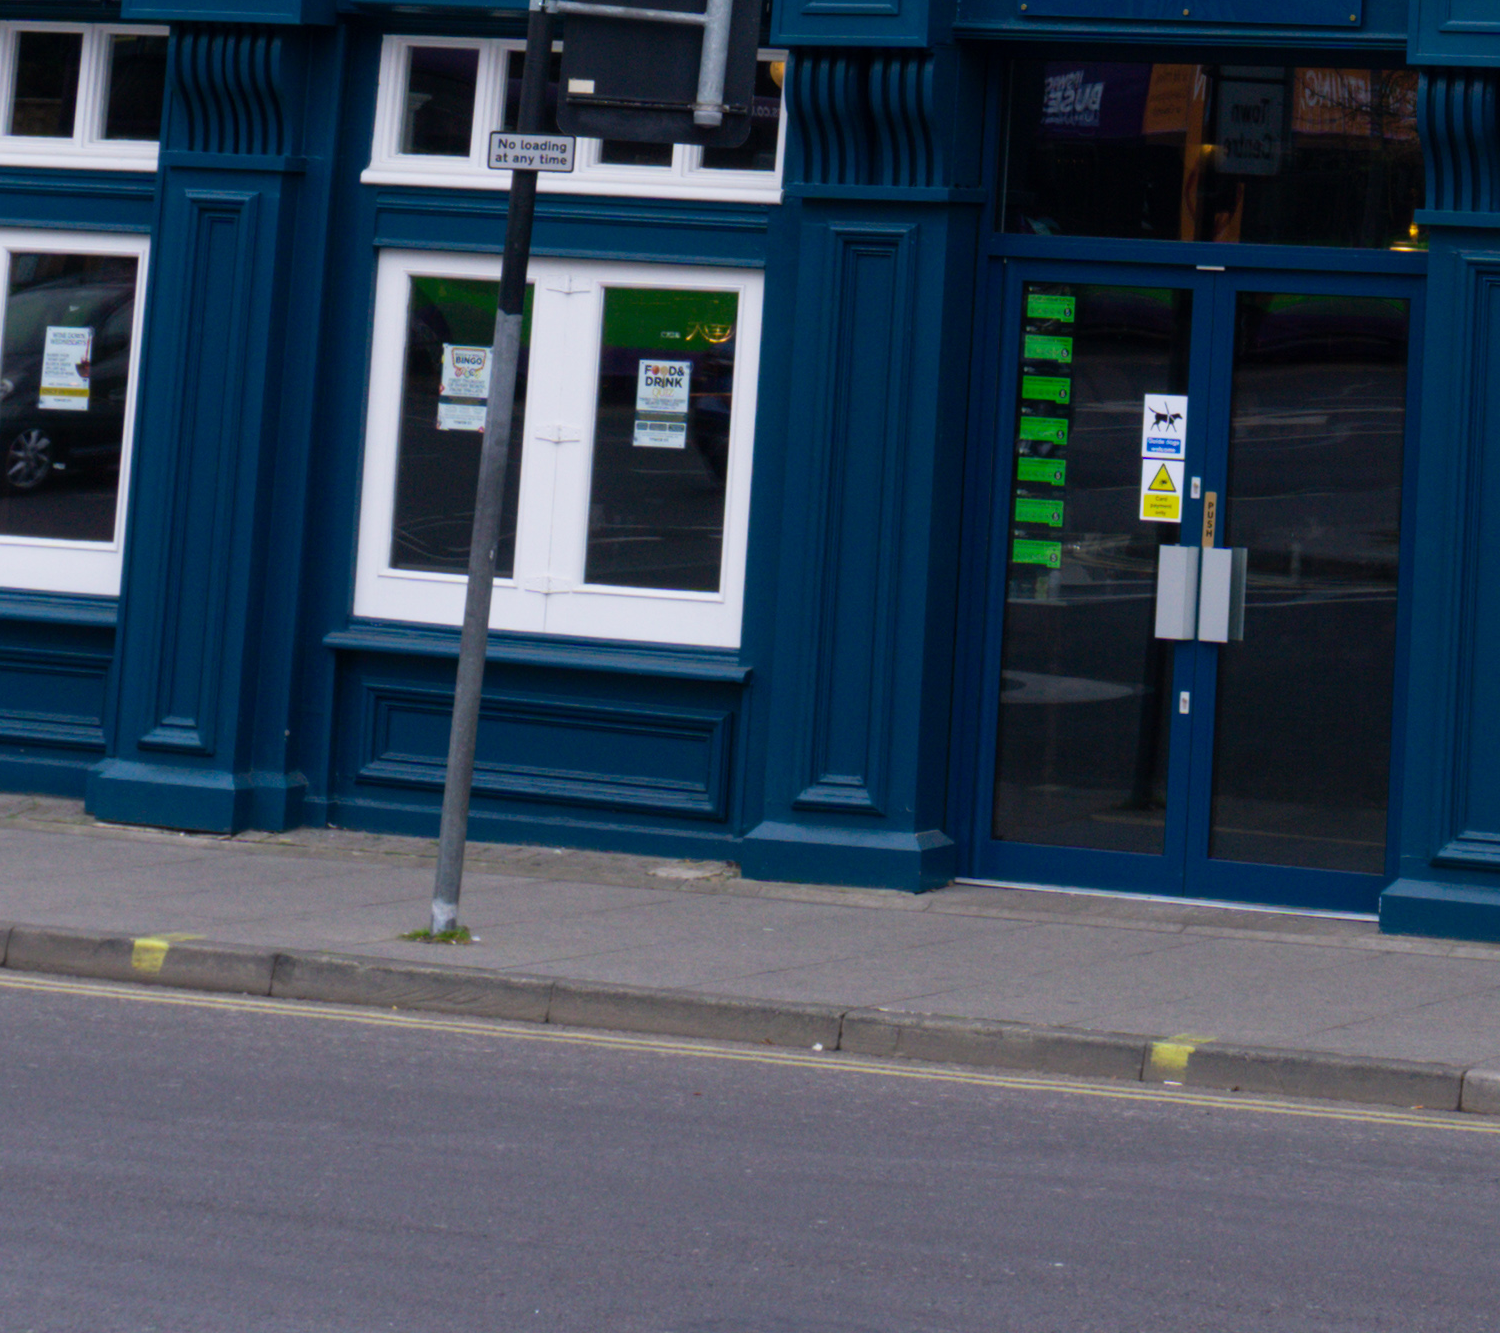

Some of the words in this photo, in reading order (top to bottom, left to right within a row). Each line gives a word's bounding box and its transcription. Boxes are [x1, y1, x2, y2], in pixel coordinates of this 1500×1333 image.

[498, 138, 516, 150] No
[520, 140, 567, 154] loading
[495, 152, 508, 163] at
[512, 154, 534, 166] any
[539, 154, 567, 166] time
[455, 356, 483, 365] BINGO
[645, 376, 683, 388] DRINK
[1206, 502, 1214, 537] PUSH
